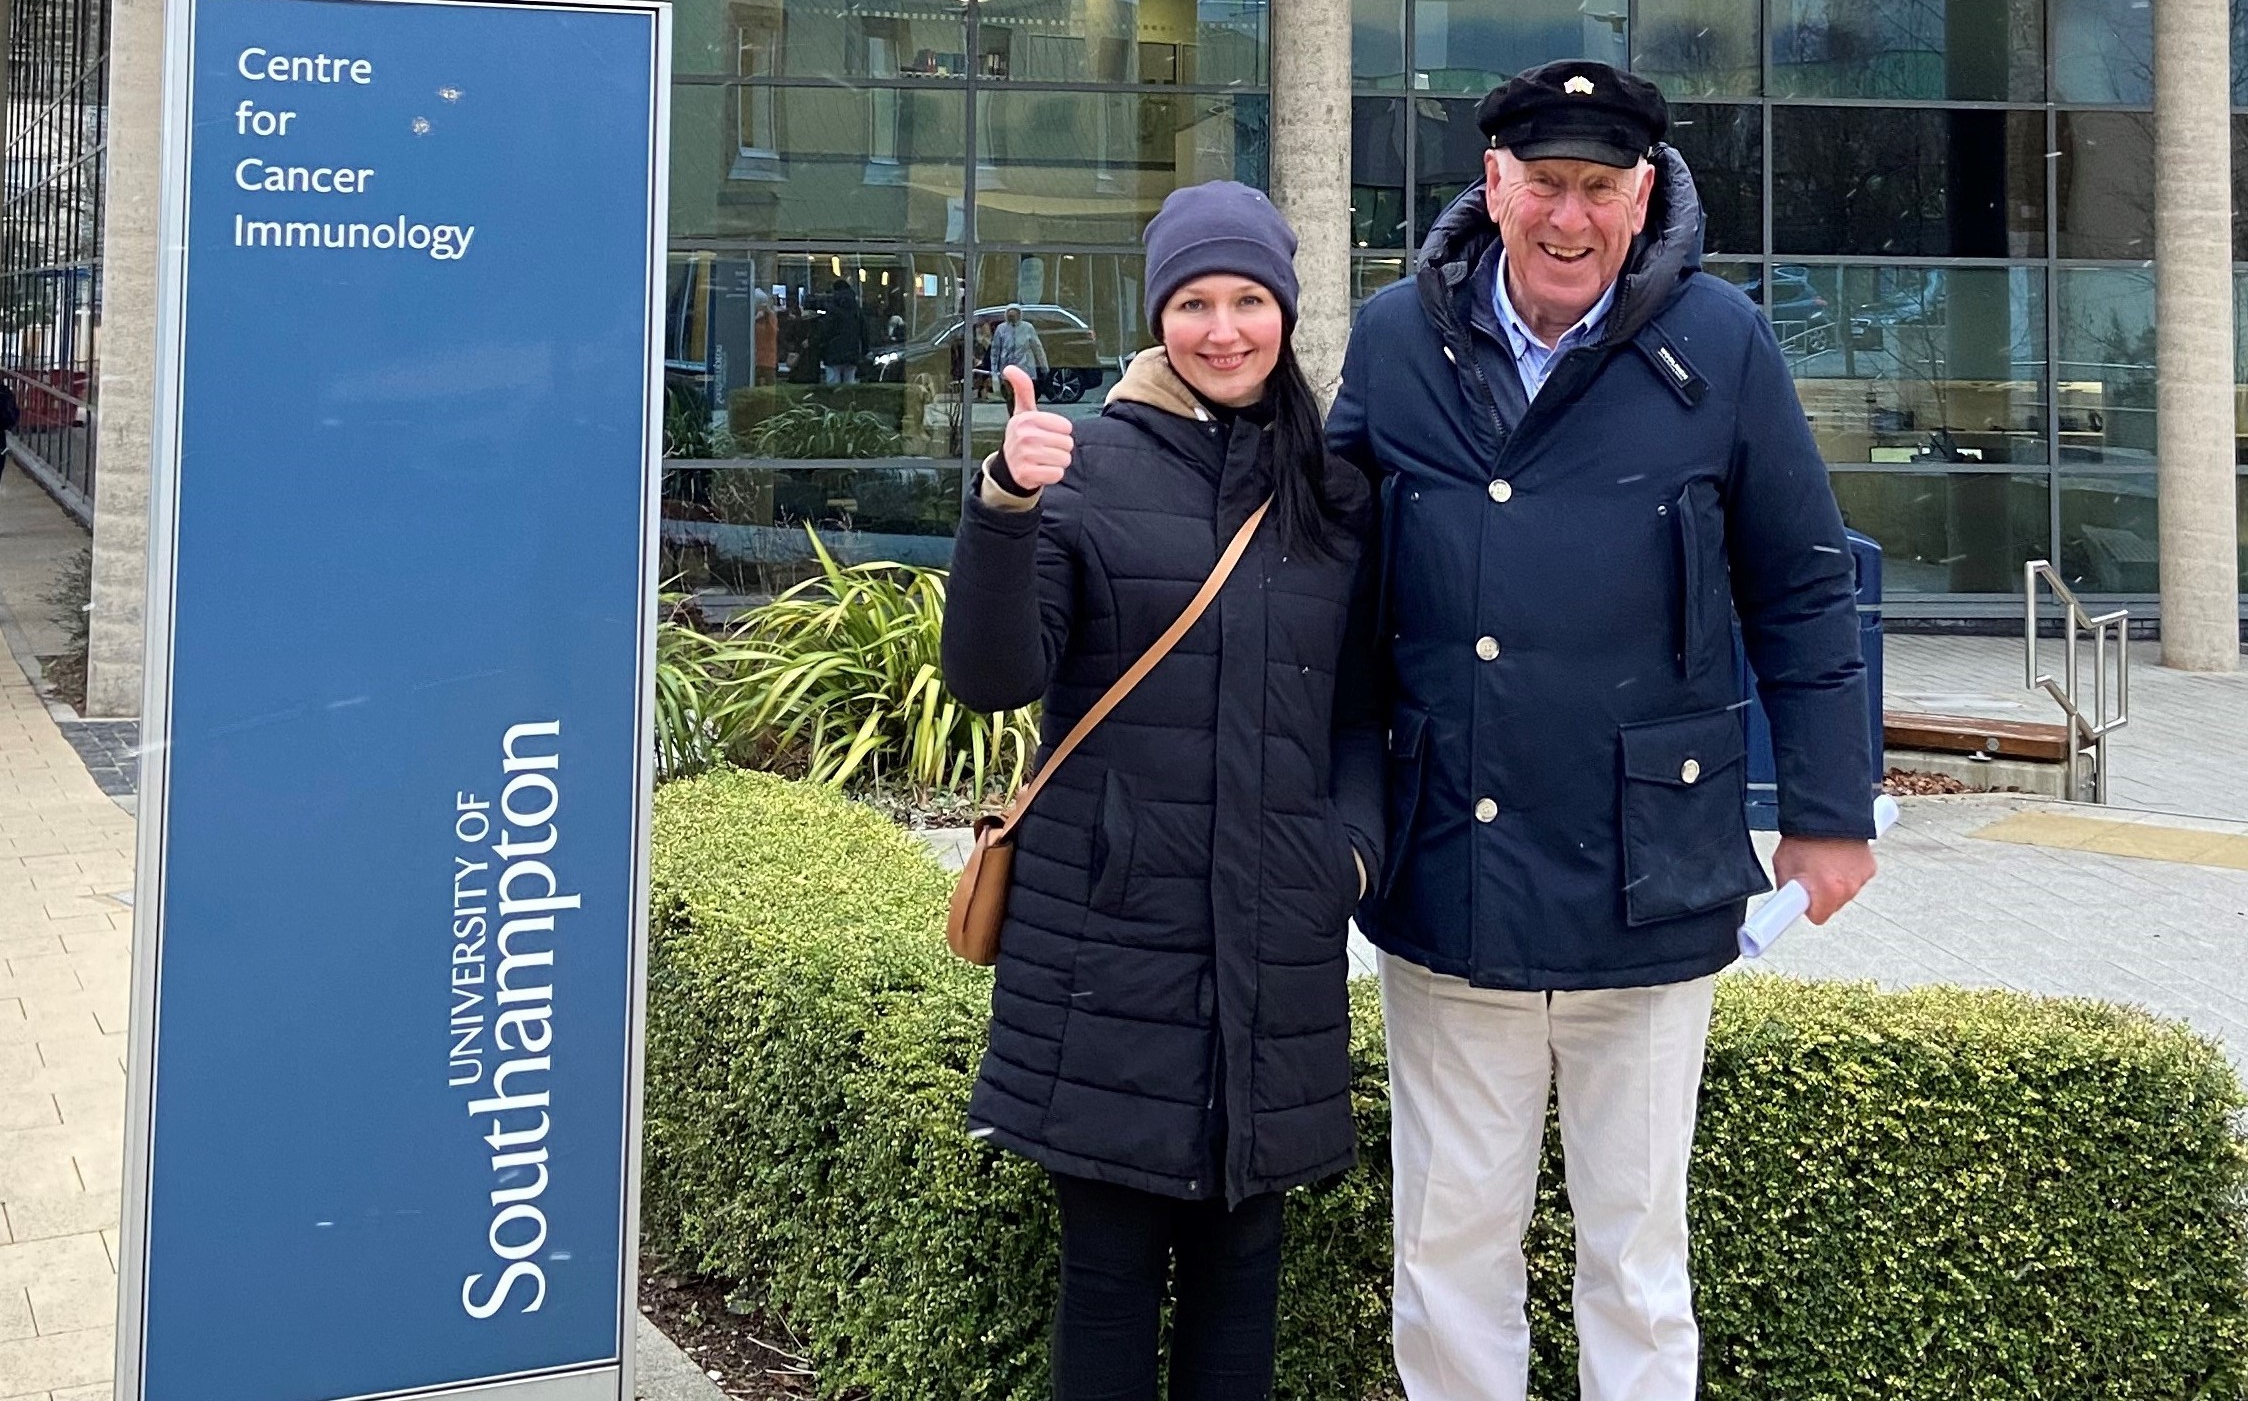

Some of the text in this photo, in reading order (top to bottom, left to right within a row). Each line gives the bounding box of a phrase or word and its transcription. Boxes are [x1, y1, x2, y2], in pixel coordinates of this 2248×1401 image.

[238, 47, 372, 84] Centre
[235, 100, 297, 136] for
[235, 158, 375, 193] Cancer
[234, 214, 475, 260] Immunology
[448, 791, 490, 1086] UNIVERSITY OF
[462, 719, 581, 1319] Southampton
